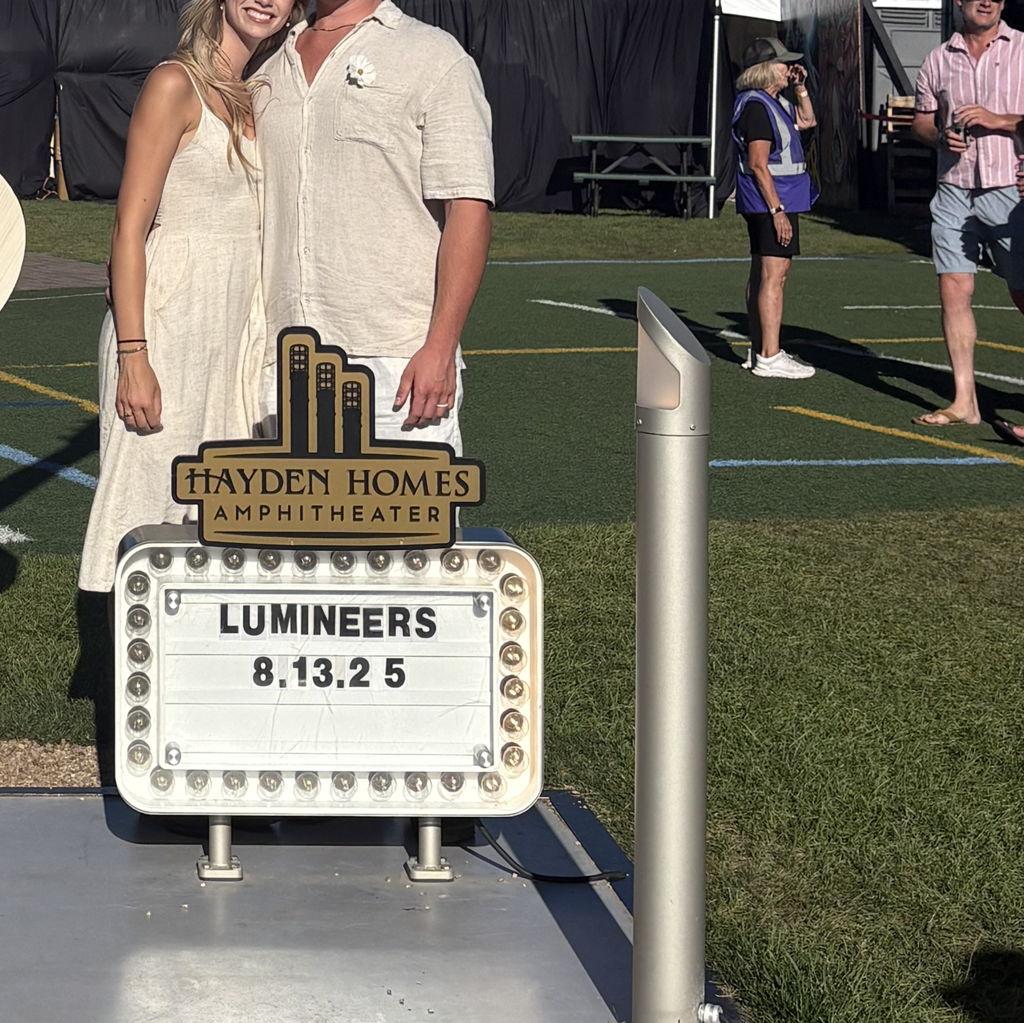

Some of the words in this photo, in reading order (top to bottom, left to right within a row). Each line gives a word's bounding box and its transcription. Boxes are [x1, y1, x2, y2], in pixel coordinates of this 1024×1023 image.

[185, 468, 329, 495] HAYDEN
[348, 470, 469, 497] HOMES
[214, 505, 440, 523] AMPHITHEATER
[220, 604, 437, 638] LUMINEERS
